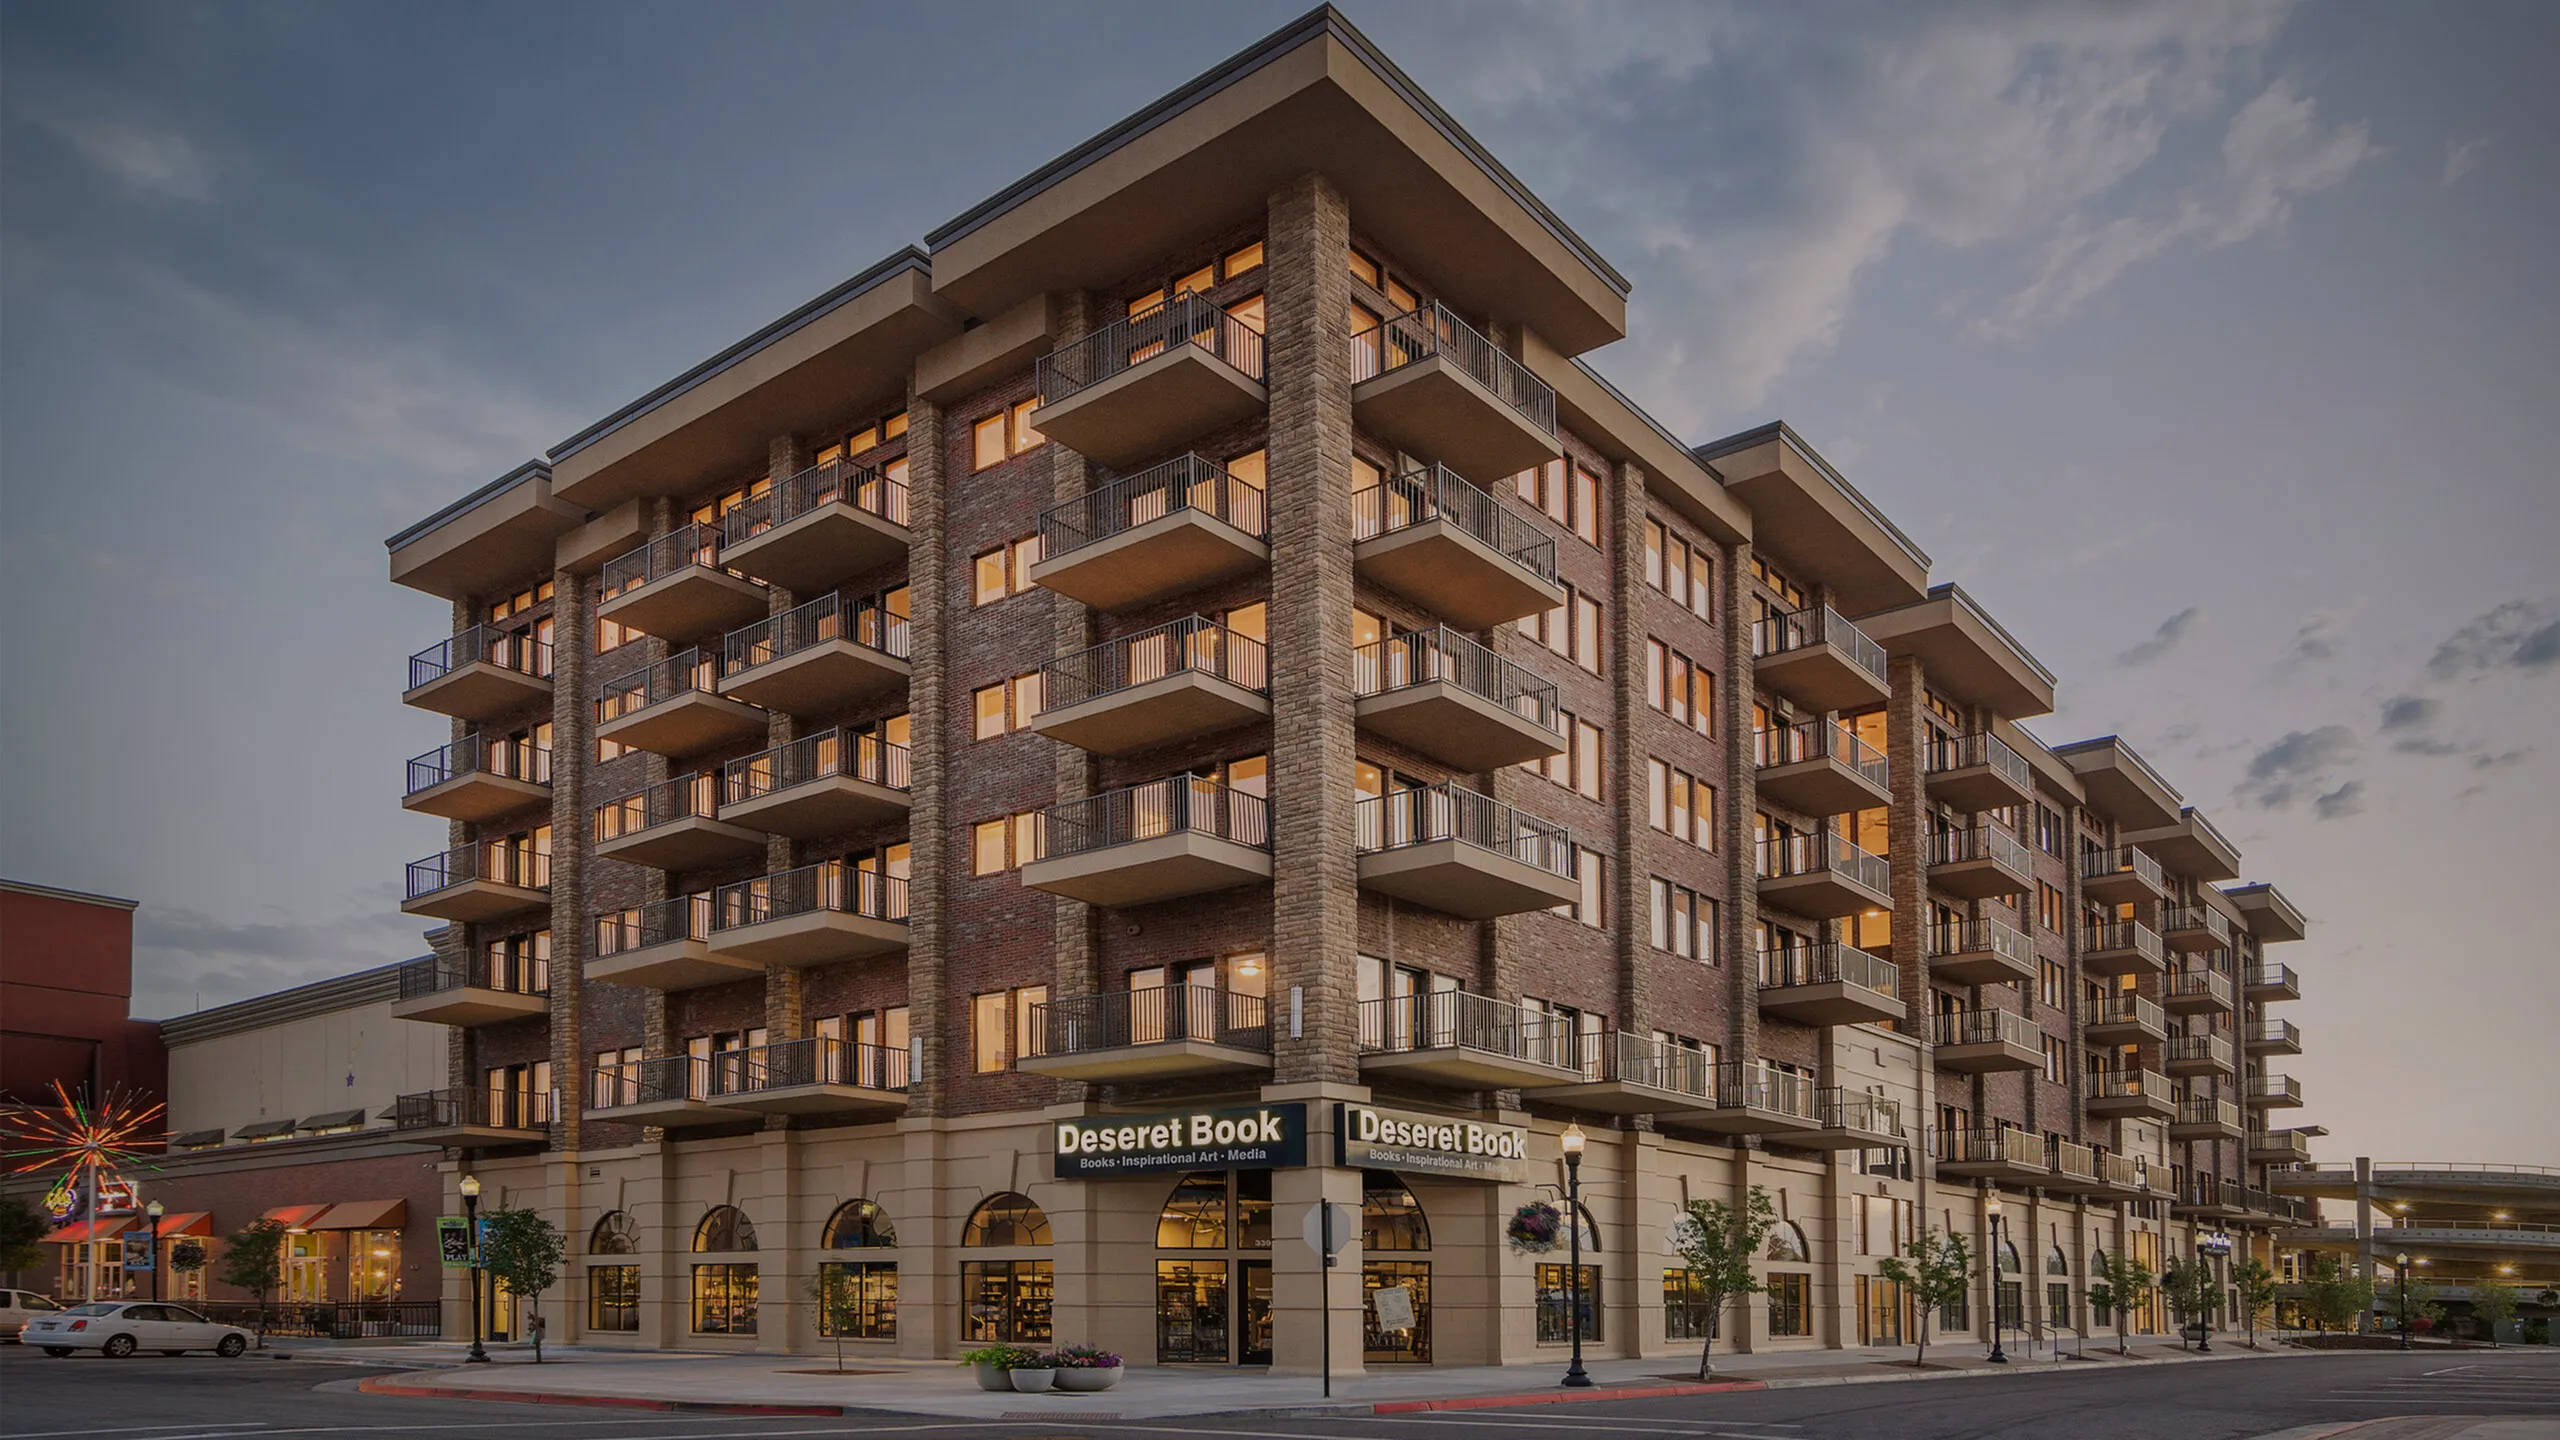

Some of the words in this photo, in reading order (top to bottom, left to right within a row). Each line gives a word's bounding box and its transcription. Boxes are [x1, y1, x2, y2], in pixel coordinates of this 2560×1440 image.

[1058, 1117, 1183, 1154] Deseret
[1190, 1109, 1282, 1147] Book
[1360, 1108, 1463, 1152] Deseret
[1467, 1124, 1527, 1160] Book
[1080, 1157, 1116, 1169] Books
[1121, 1151, 1196, 1169] Inspirational
[1198, 1151, 1218, 1163] Art
[1227, 1147, 1267, 1161] Media
[1369, 1148, 1402, 1163] Books
[1406, 1152, 1463, 1169] Inspirational
[1463, 1159, 1479, 1171] Art
[1483, 1160, 1510, 1174] Mea
